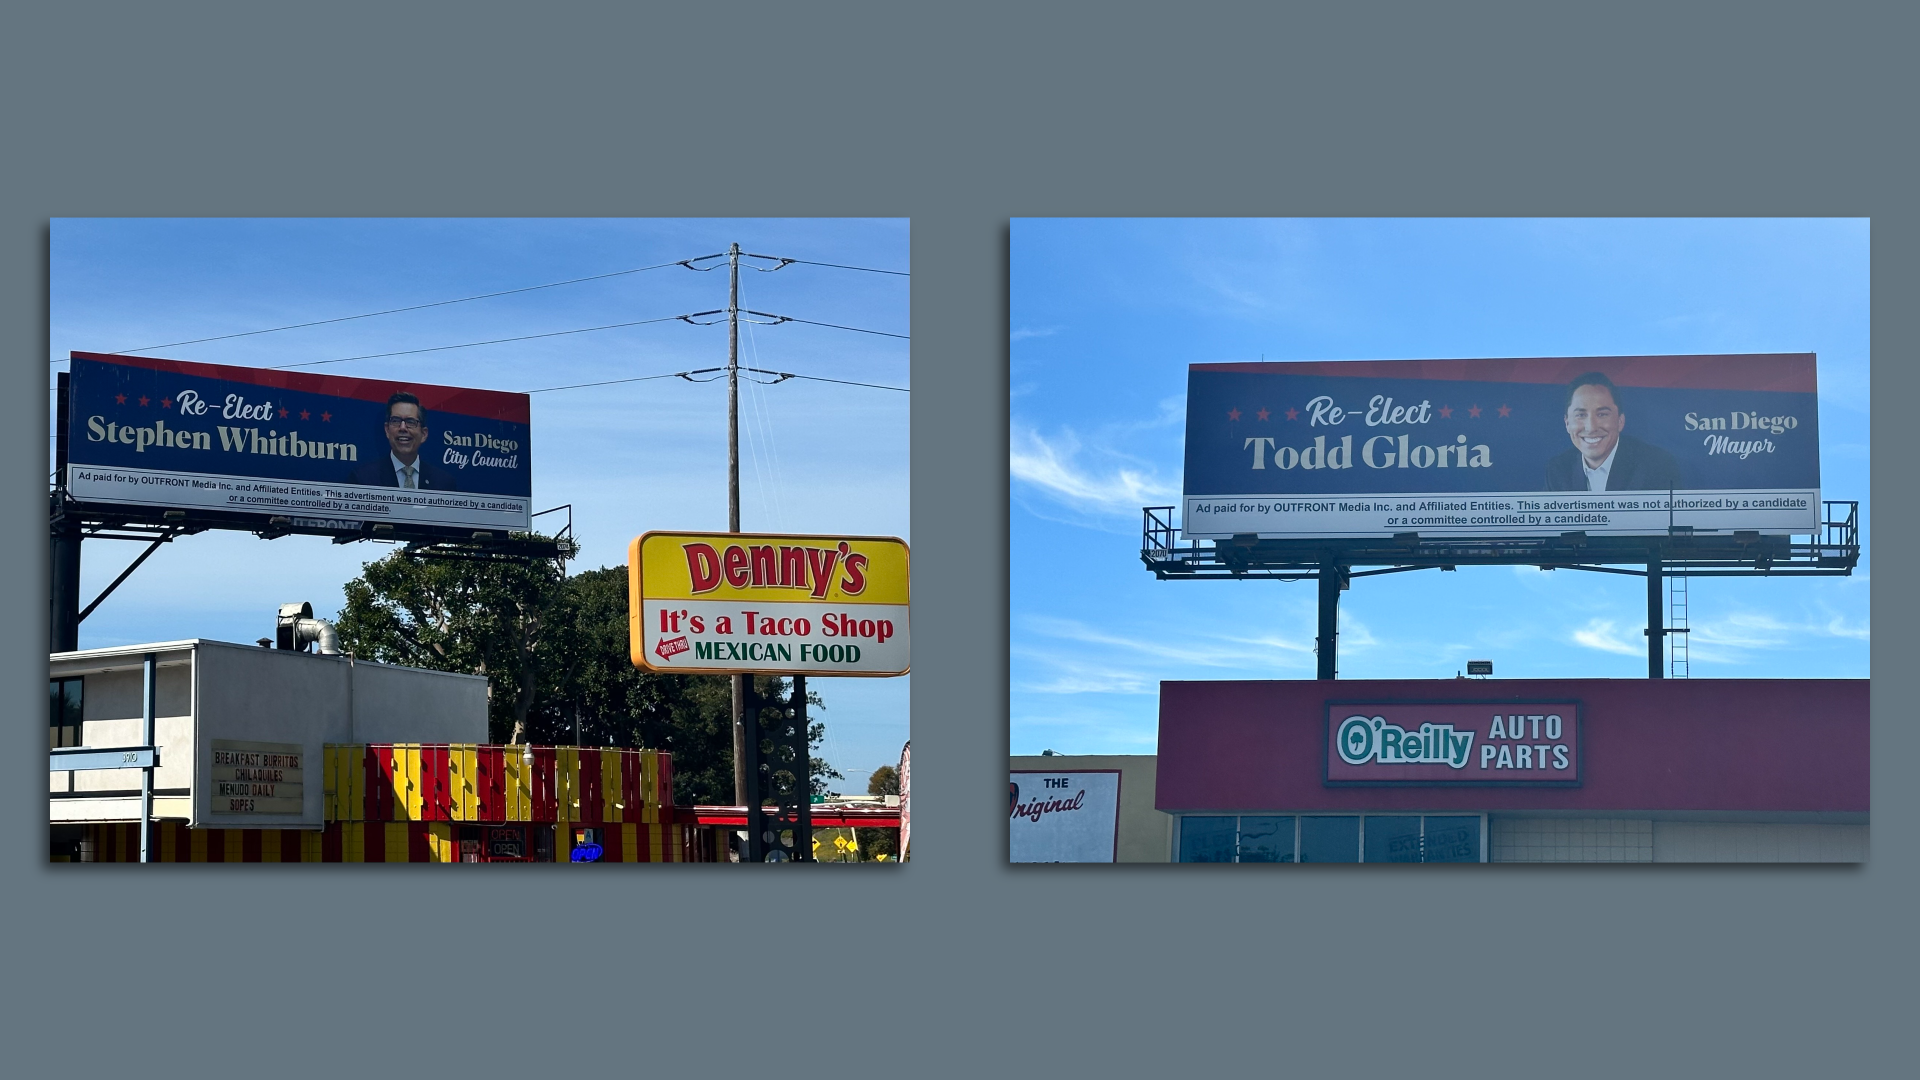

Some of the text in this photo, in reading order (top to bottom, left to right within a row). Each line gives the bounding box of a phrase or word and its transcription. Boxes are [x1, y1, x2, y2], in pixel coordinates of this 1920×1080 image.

[176, 389, 273, 421] Re-Elect
[1305, 395, 1432, 426] Re-Elect
[1684, 411, 1798, 435] San Diego
[87, 415, 358, 462] Stephen Whitburn
[443, 430, 518, 454] San Diego
[1703, 434, 1776, 460] Mayor
[443, 448, 518, 470] City Council
[1243, 434, 1493, 470] Todd Gloria
[78, 471, 91, 480] Ad
[93, 472, 112, 483] paid
[114, 473, 126, 483] for
[128, 474, 139, 486] by
[141, 476, 190, 488] OUTFRONT
[192, 480, 217, 490] Media
[218, 482, 233, 491] Inc.
[235, 484, 251, 492] and
[253, 484, 289, 495] Affiliated
[291, 487, 323, 497] Entities.
[325, 489, 342, 499] This
[344, 490, 395, 502] advertisment
[396, 495, 412, 503] was
[413, 496, 427, 505] not
[428, 497, 468, 507] authorized
[470, 499, 479, 509] by
[487, 501, 523, 511] candidate
[246, 495, 289, 505] committee
[290, 497, 331, 508] controlled
[332, 500, 343, 510] by
[351, 501, 391, 513] candidate.
[1196, 498, 1807, 515] Ad paid for by OUTFRONT Media Inc. and Affiliated Entities. This advertisment was not authorized by a candidate
[1387, 513, 1611, 526] or a committee controlled by a candidate.
[682, 541, 868, 599] Denny's
[659, 608, 894, 643] It's a Taco Shop
[660, 638, 689, 656] DRIVE THRU
[695, 641, 861, 663] MEXICAN FOOD
[1488, 715, 1562, 739] AUTO
[1338, 717, 1474, 767] O'Reilly
[215, 751, 299, 768] BREAKFAST BURRITOS
[1480, 744, 1569, 769] PARTS
[235, 768, 283, 781] CHILAQUILES
[1043, 777, 1069, 789] THE
[219, 782, 275, 797] MENUDO DAILY
[230, 798, 255, 811] SOPES
[491, 829, 520, 840] OPEN
[493, 843, 520, 855] OPEN
[571, 846, 598, 860] OPEN
